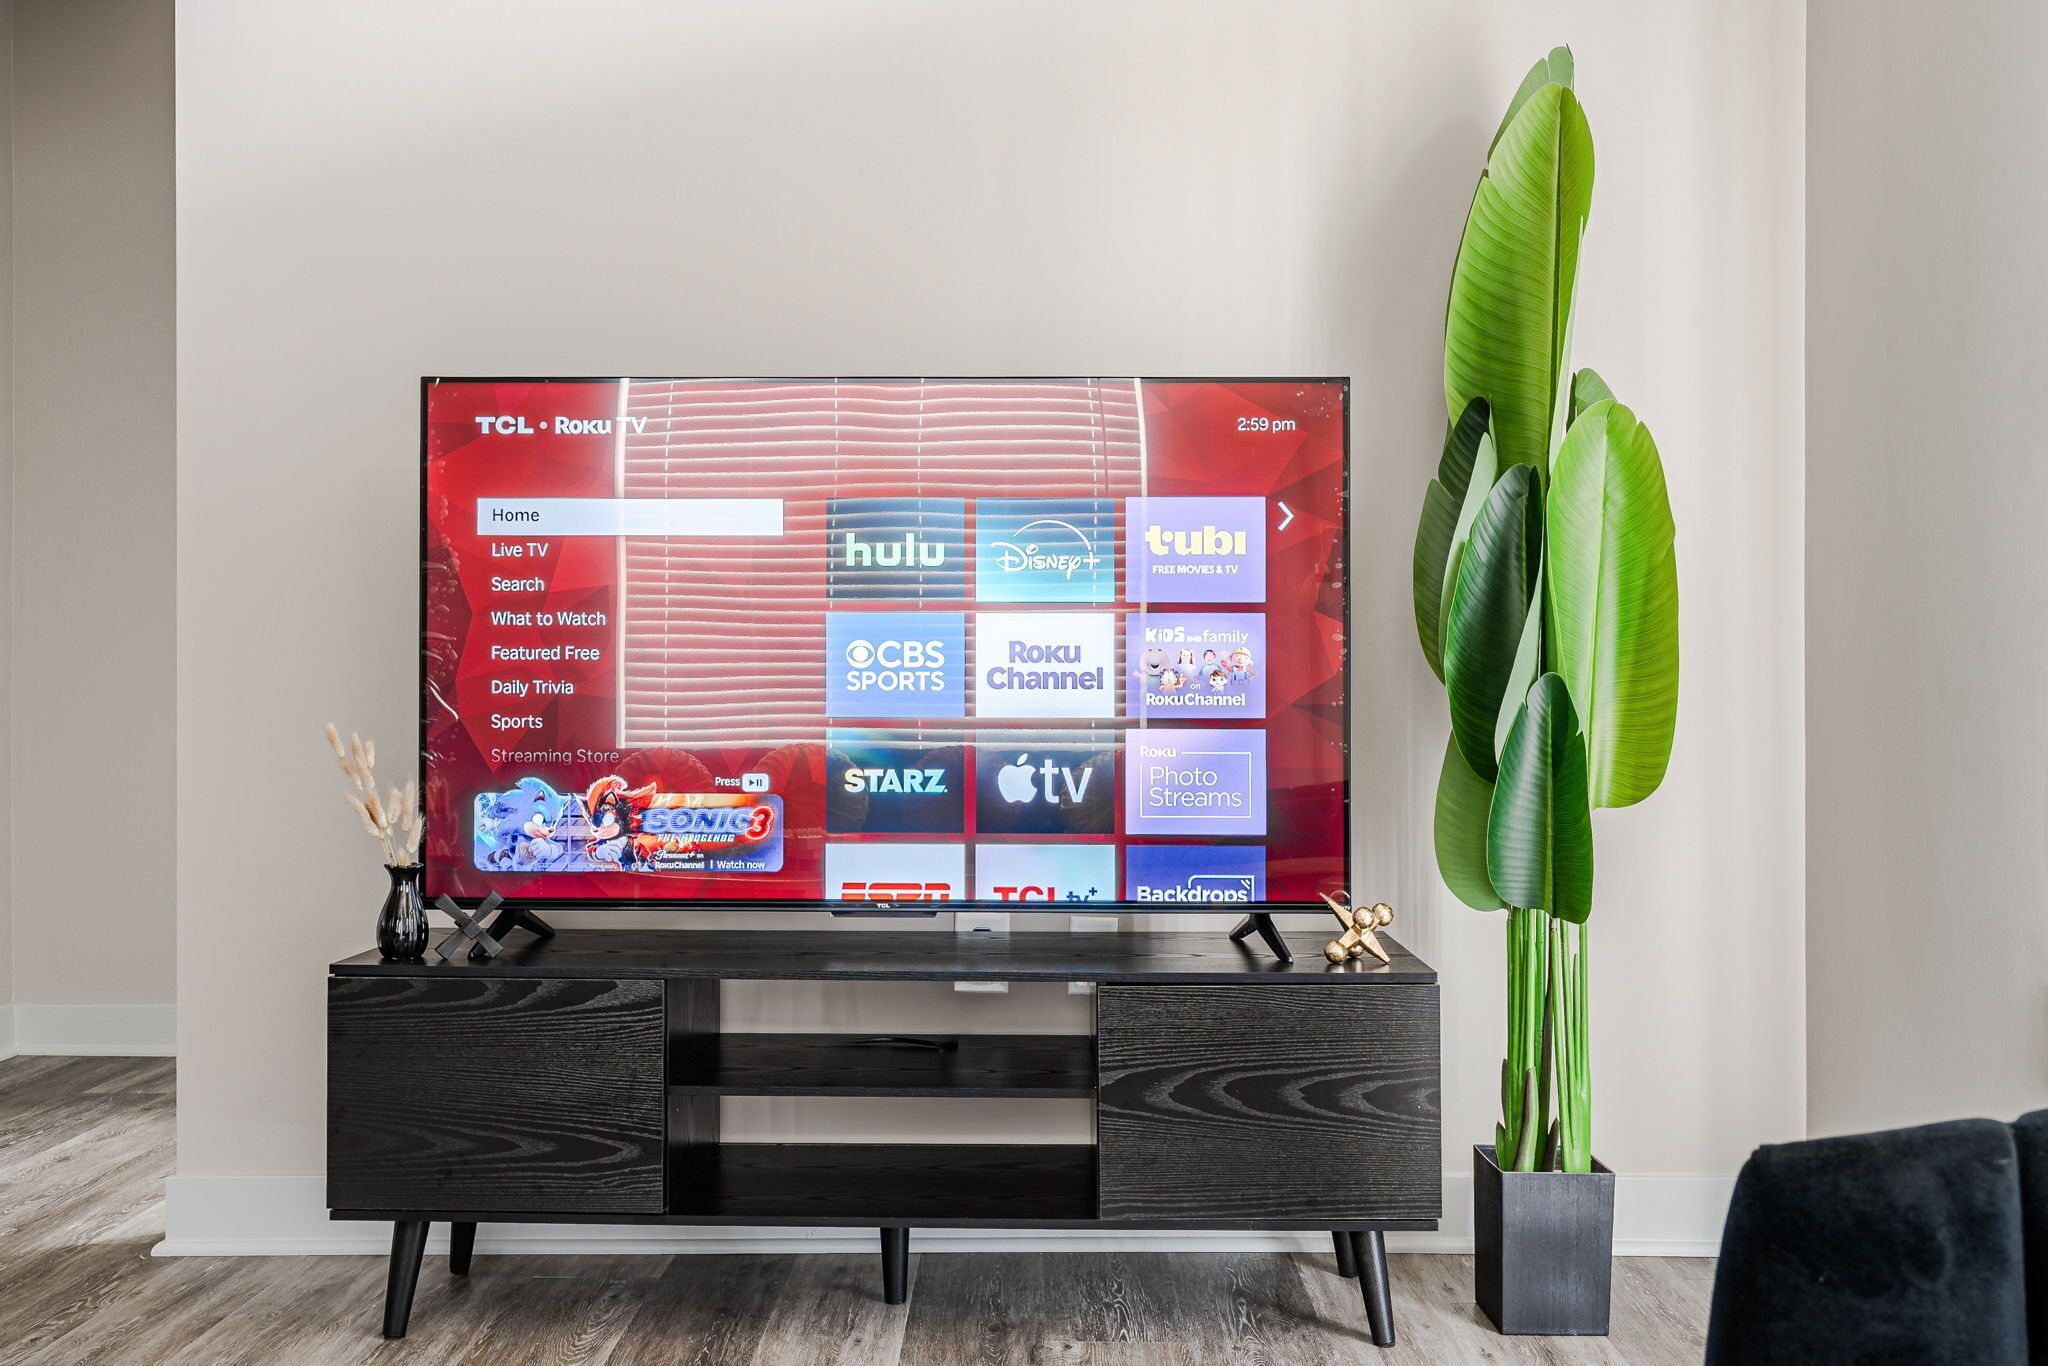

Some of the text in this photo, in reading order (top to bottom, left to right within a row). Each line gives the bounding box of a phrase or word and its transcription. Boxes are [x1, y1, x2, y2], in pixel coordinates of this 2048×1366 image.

[475, 416, 648, 434] TCL Roku TV
[1237, 417, 1296, 434] 2:59 pm
[492, 508, 540, 523] Home
[1144, 525, 1246, 556] tubi
[491, 542, 549, 558] Live TV
[845, 532, 945, 567] hulu
[1152, 564, 1239, 575] FREE MOVIES & TV
[491, 577, 545, 593] Search
[491, 611, 606, 626] What to Watch
[1202, 630, 1249, 644] family
[491, 646, 601, 661] Featured Free
[876, 640, 945, 666] CBS
[1008, 641, 1081, 664] Roku
[846, 670, 945, 691] SPORTS
[986, 667, 1103, 690] Channel
[1190, 682, 1201, 690] on
[491, 680, 574, 697] Daily Trivia
[491, 714, 543, 732] Sports
[491, 749, 619, 766] Streaming Store
[1140, 746, 1176, 758] Roku
[715, 776, 741, 787] Press
[1040, 758, 1093, 804] tv
[1150, 765, 1218, 787] Photo
[1149, 787, 1242, 807] Streams
[645, 805, 775, 840] SONIC 3
[717, 861, 745, 869] Watch
[1137, 885, 1248, 902] Backdrops
